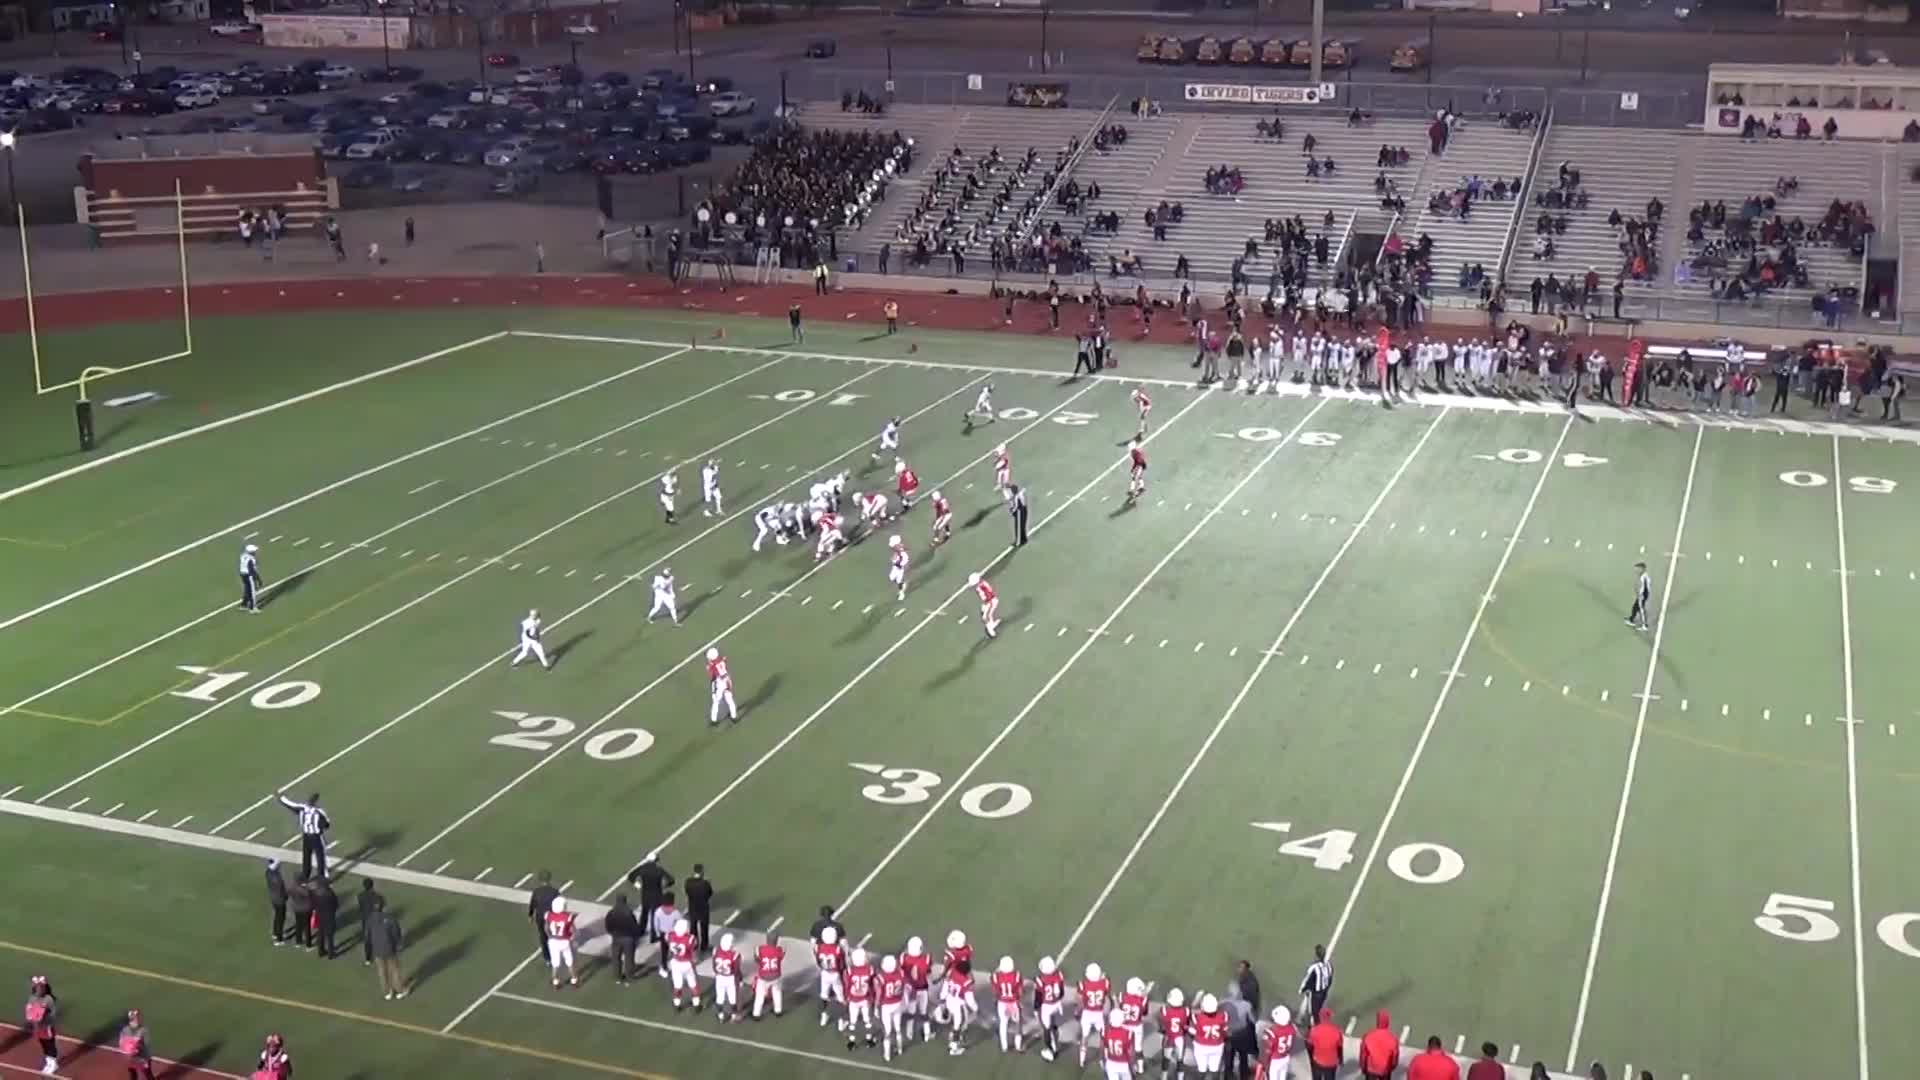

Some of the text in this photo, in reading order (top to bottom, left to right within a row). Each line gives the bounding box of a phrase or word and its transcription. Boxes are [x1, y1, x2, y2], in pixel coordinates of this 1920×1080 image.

[1201, 86, 1304, 100] IRVING TIGERS
[1001, 982, 1013, 998] 11
[1086, 990, 1103, 1007] 32
[1170, 1017, 1181, 1033] 5
[1108, 1038, 1123, 1056] 16
